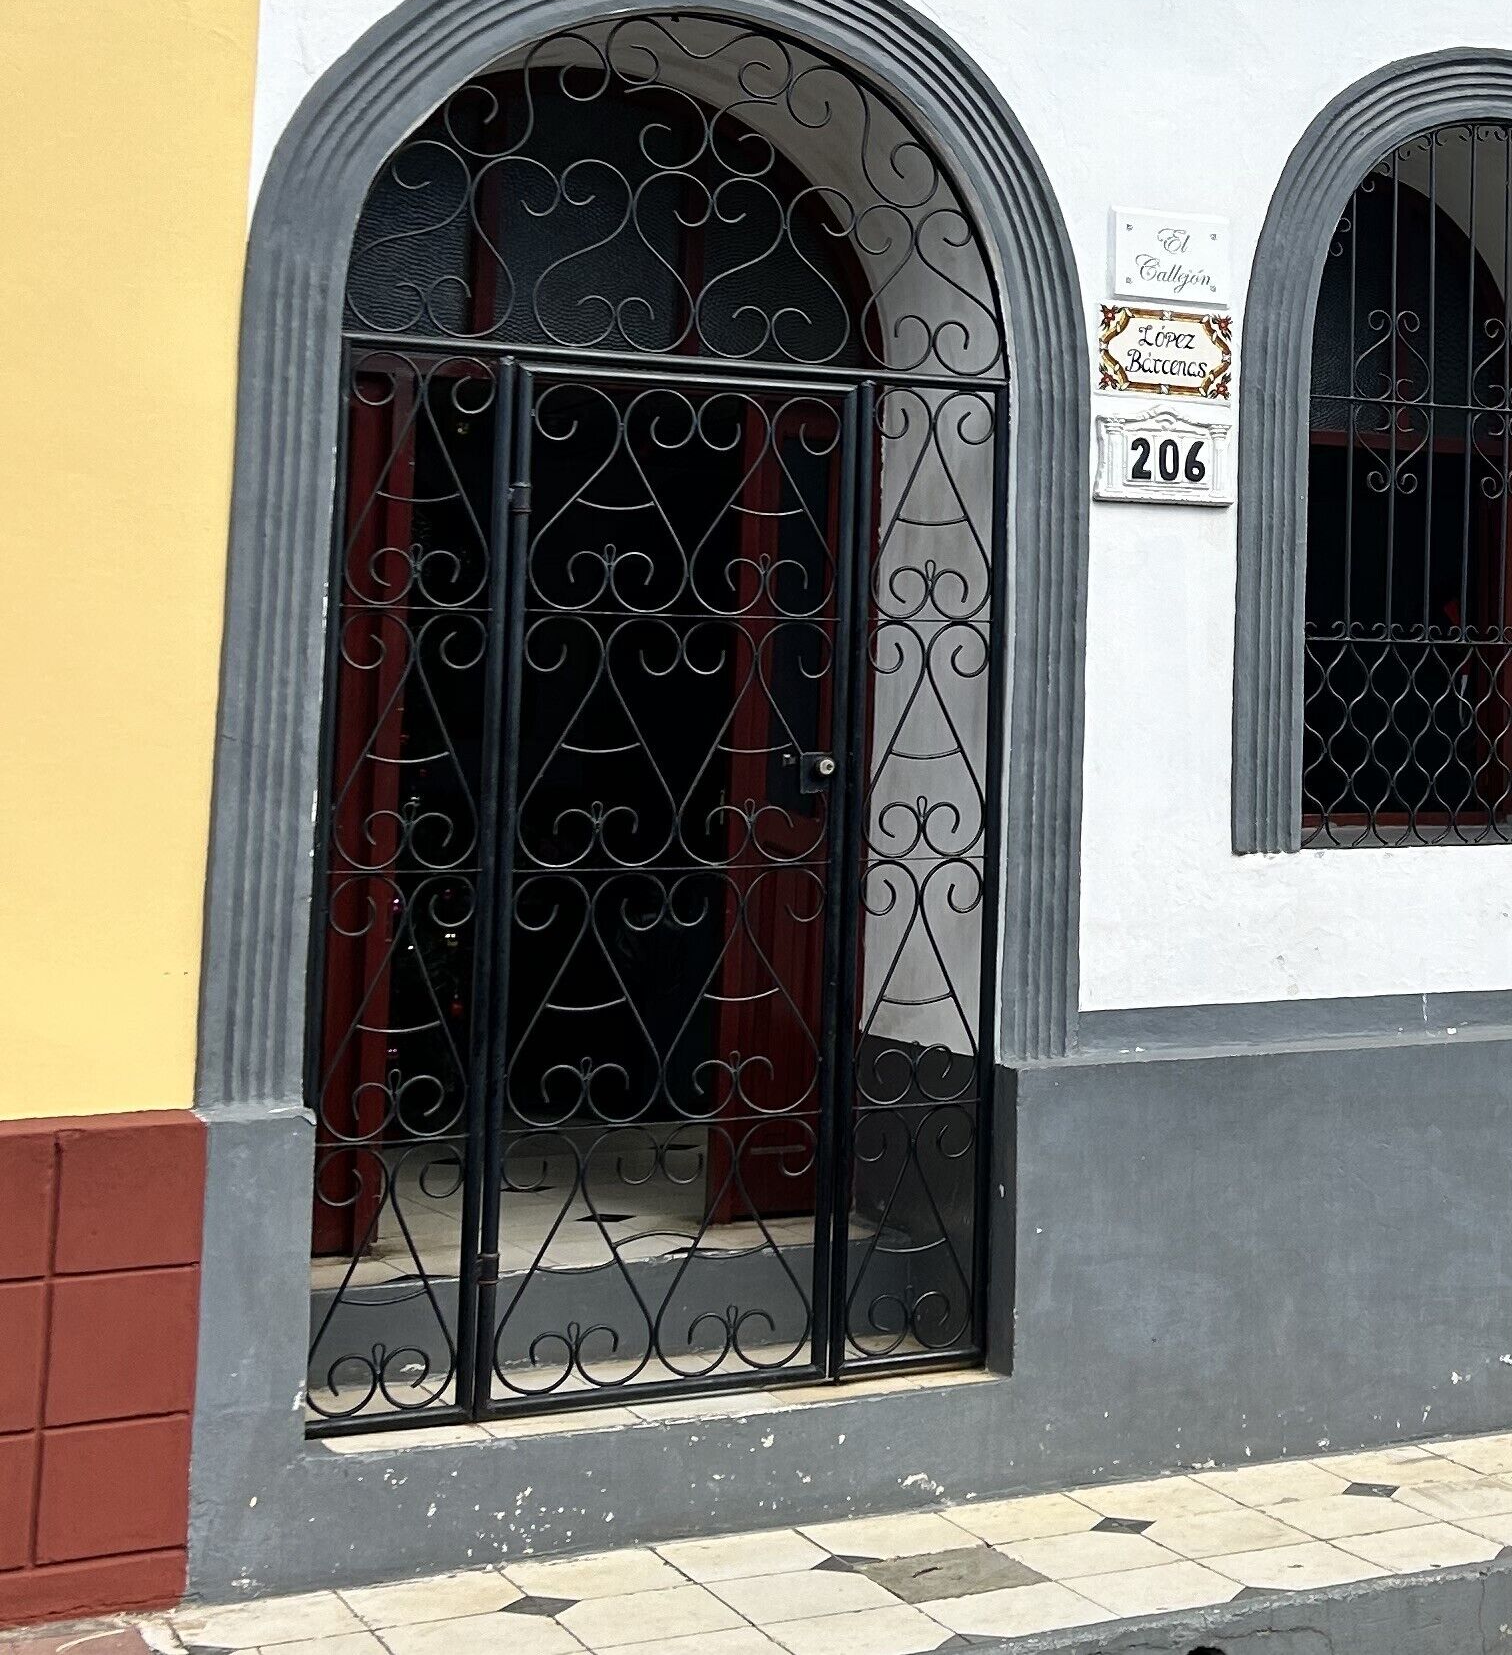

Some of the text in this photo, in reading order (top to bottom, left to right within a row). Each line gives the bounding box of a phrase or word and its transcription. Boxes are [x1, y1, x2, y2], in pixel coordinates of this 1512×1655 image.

[1157, 228, 1190, 254] El
[1135, 254, 1210, 293] Callejón
[1138, 324, 1196, 349] López
[1125, 348, 1208, 378] Bárcenas
[1131, 438, 1205, 481] 206
